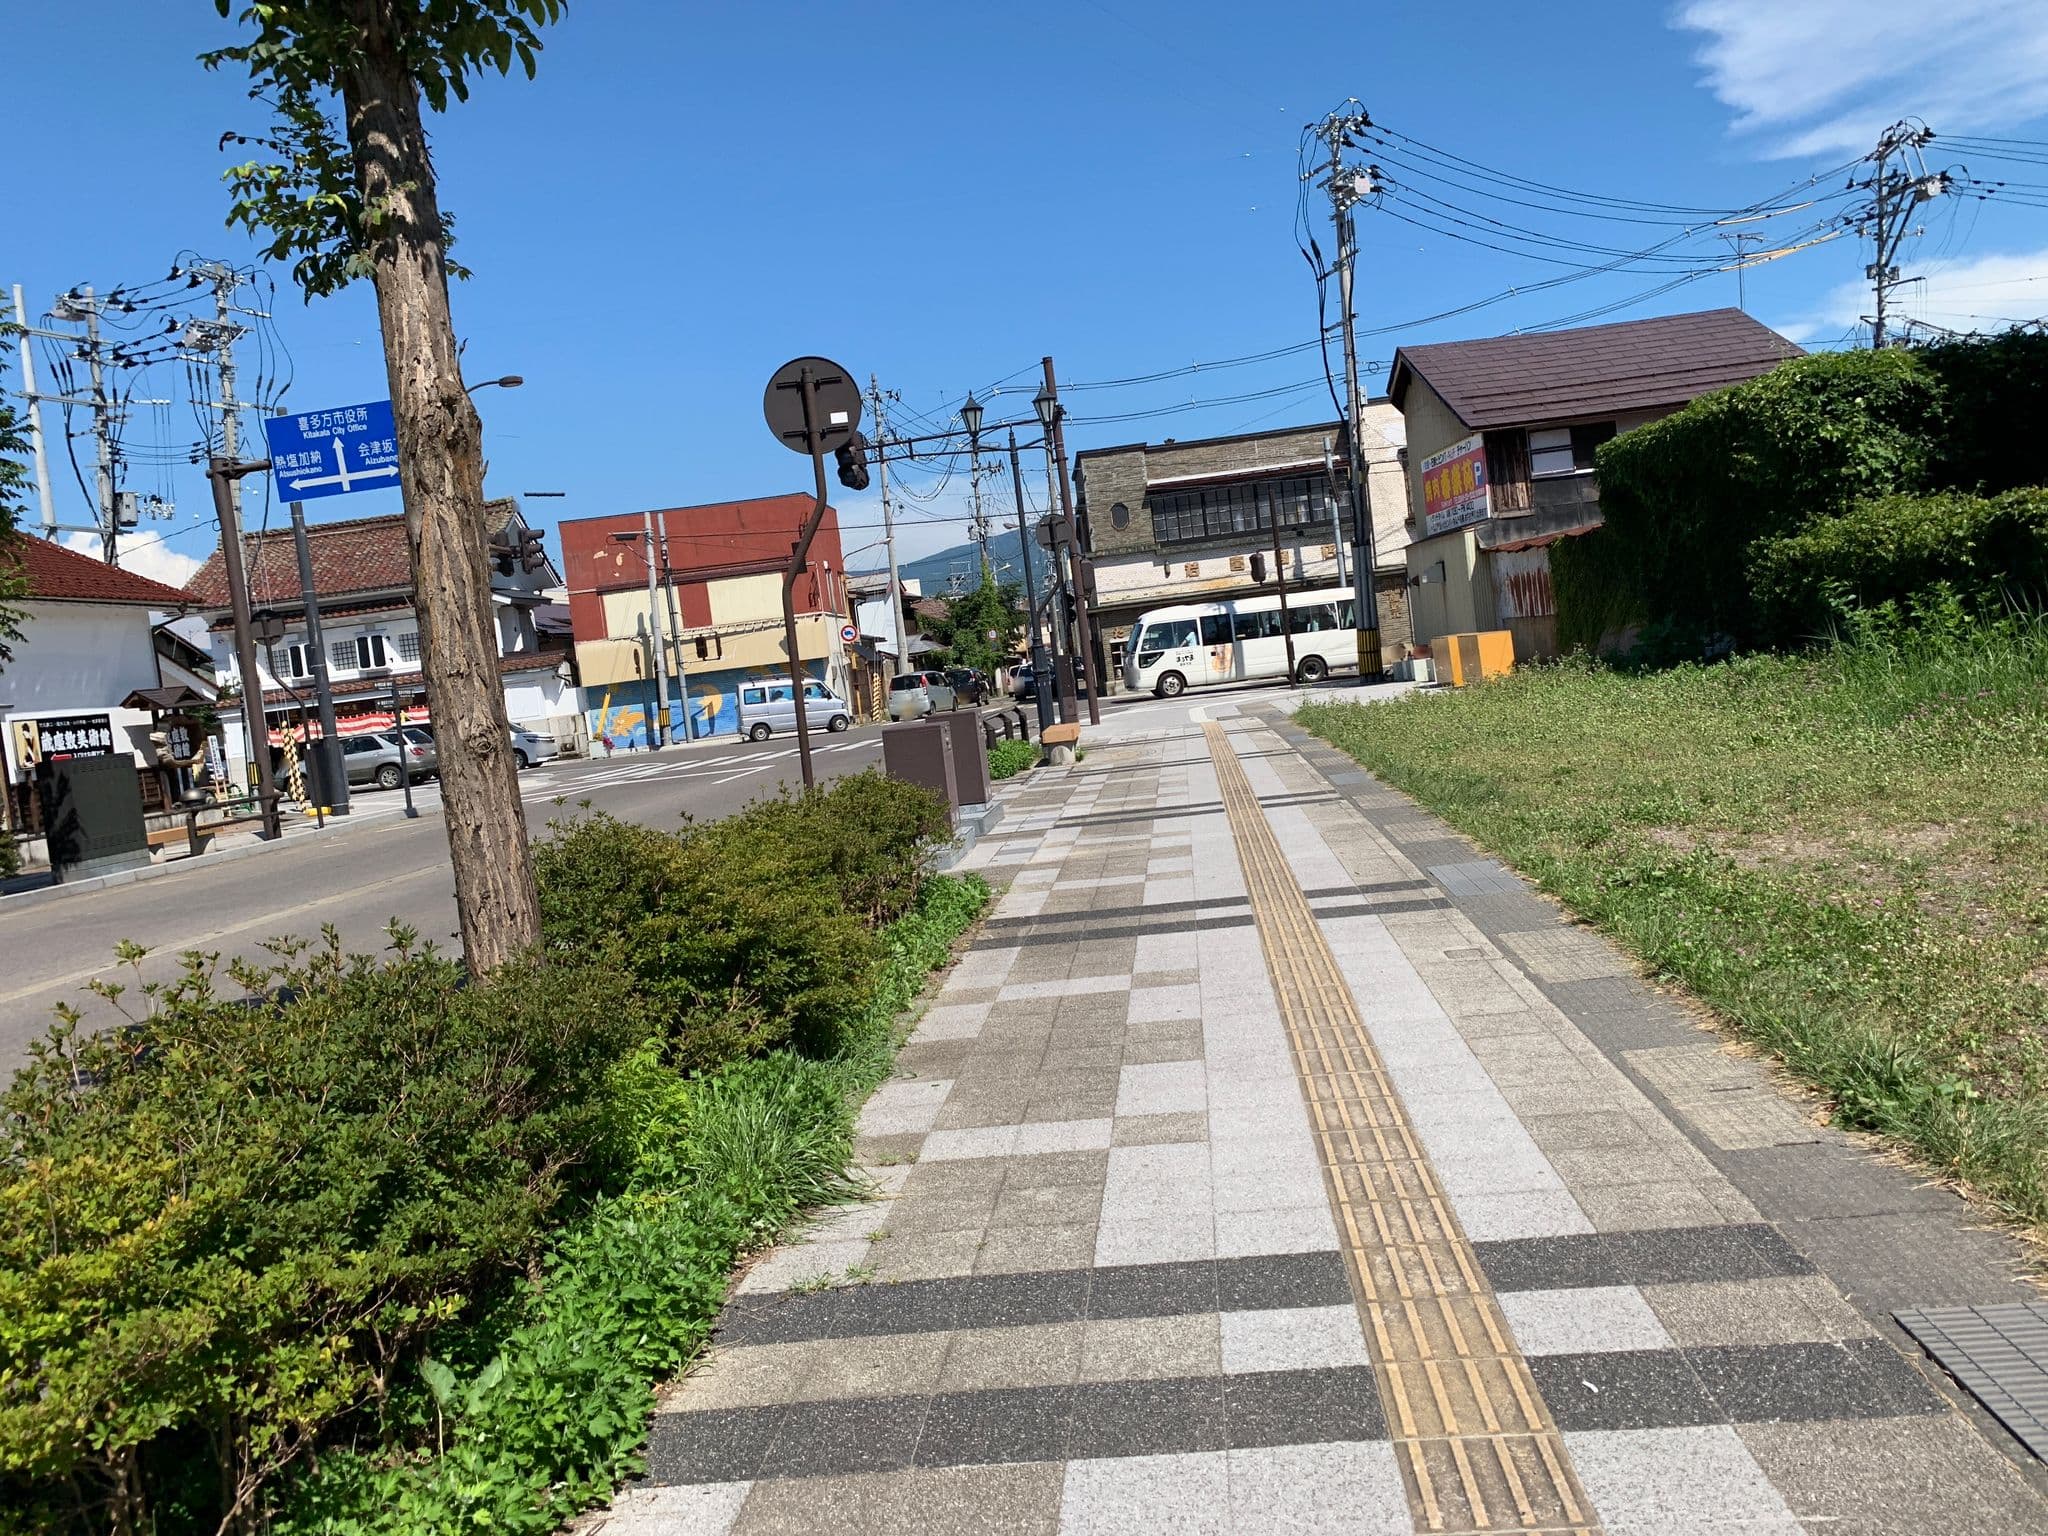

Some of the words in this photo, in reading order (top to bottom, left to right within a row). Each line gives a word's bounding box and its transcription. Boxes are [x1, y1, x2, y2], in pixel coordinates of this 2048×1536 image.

[297, 407, 368, 431] 喜多方市役所
[303, 428, 331, 440] Kitakata
[332, 425, 345, 436] City
[347, 423, 368, 433] Office
[357, 438, 397, 458] 会津坂
[274, 450, 322, 470] 熱塩加納
[365, 455, 399, 466] Aizubang
